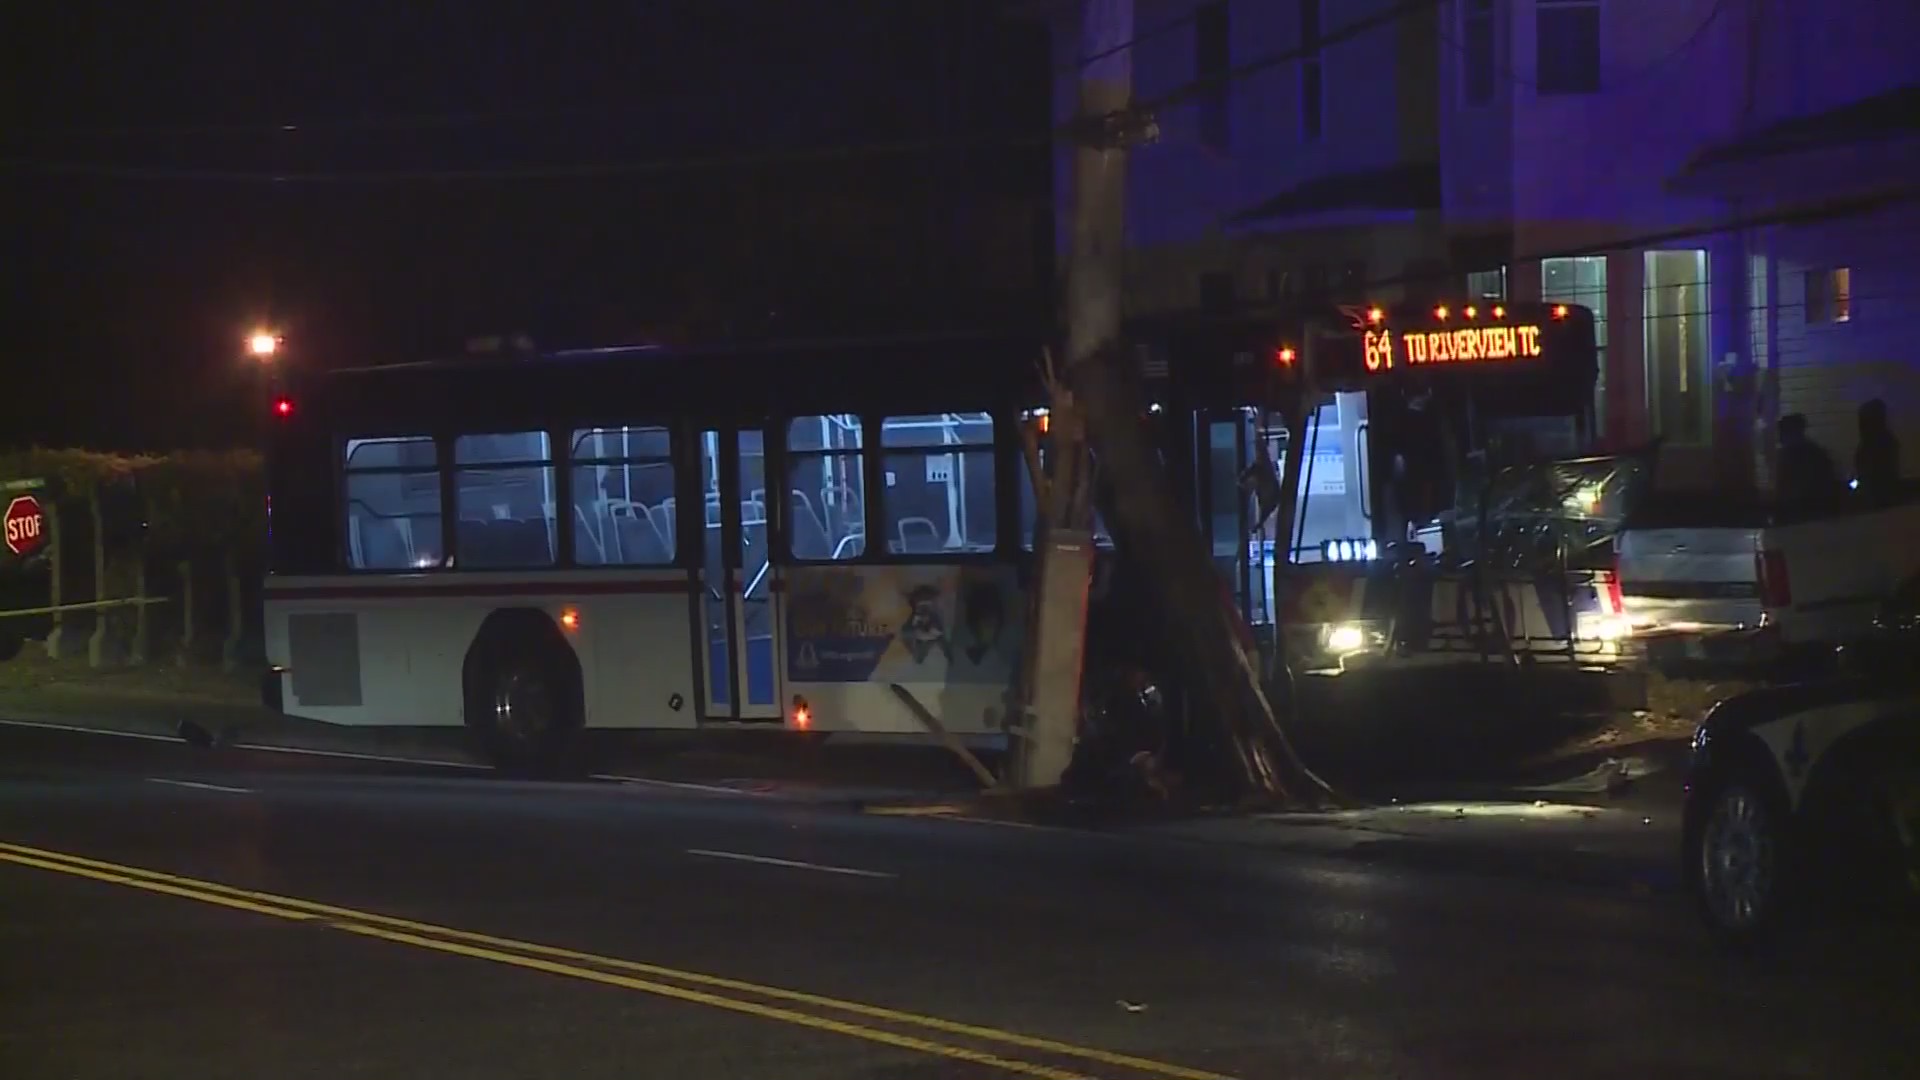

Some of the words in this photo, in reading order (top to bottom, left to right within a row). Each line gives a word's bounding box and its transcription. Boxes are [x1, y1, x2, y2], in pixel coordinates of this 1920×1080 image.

[1364, 328, 1393, 372] 64
[1403, 331, 1427, 364] TO
[1428, 325, 1517, 362] RIVERVIEW
[1517, 324, 1542, 358] TC
[7, 514, 42, 541] STOP
